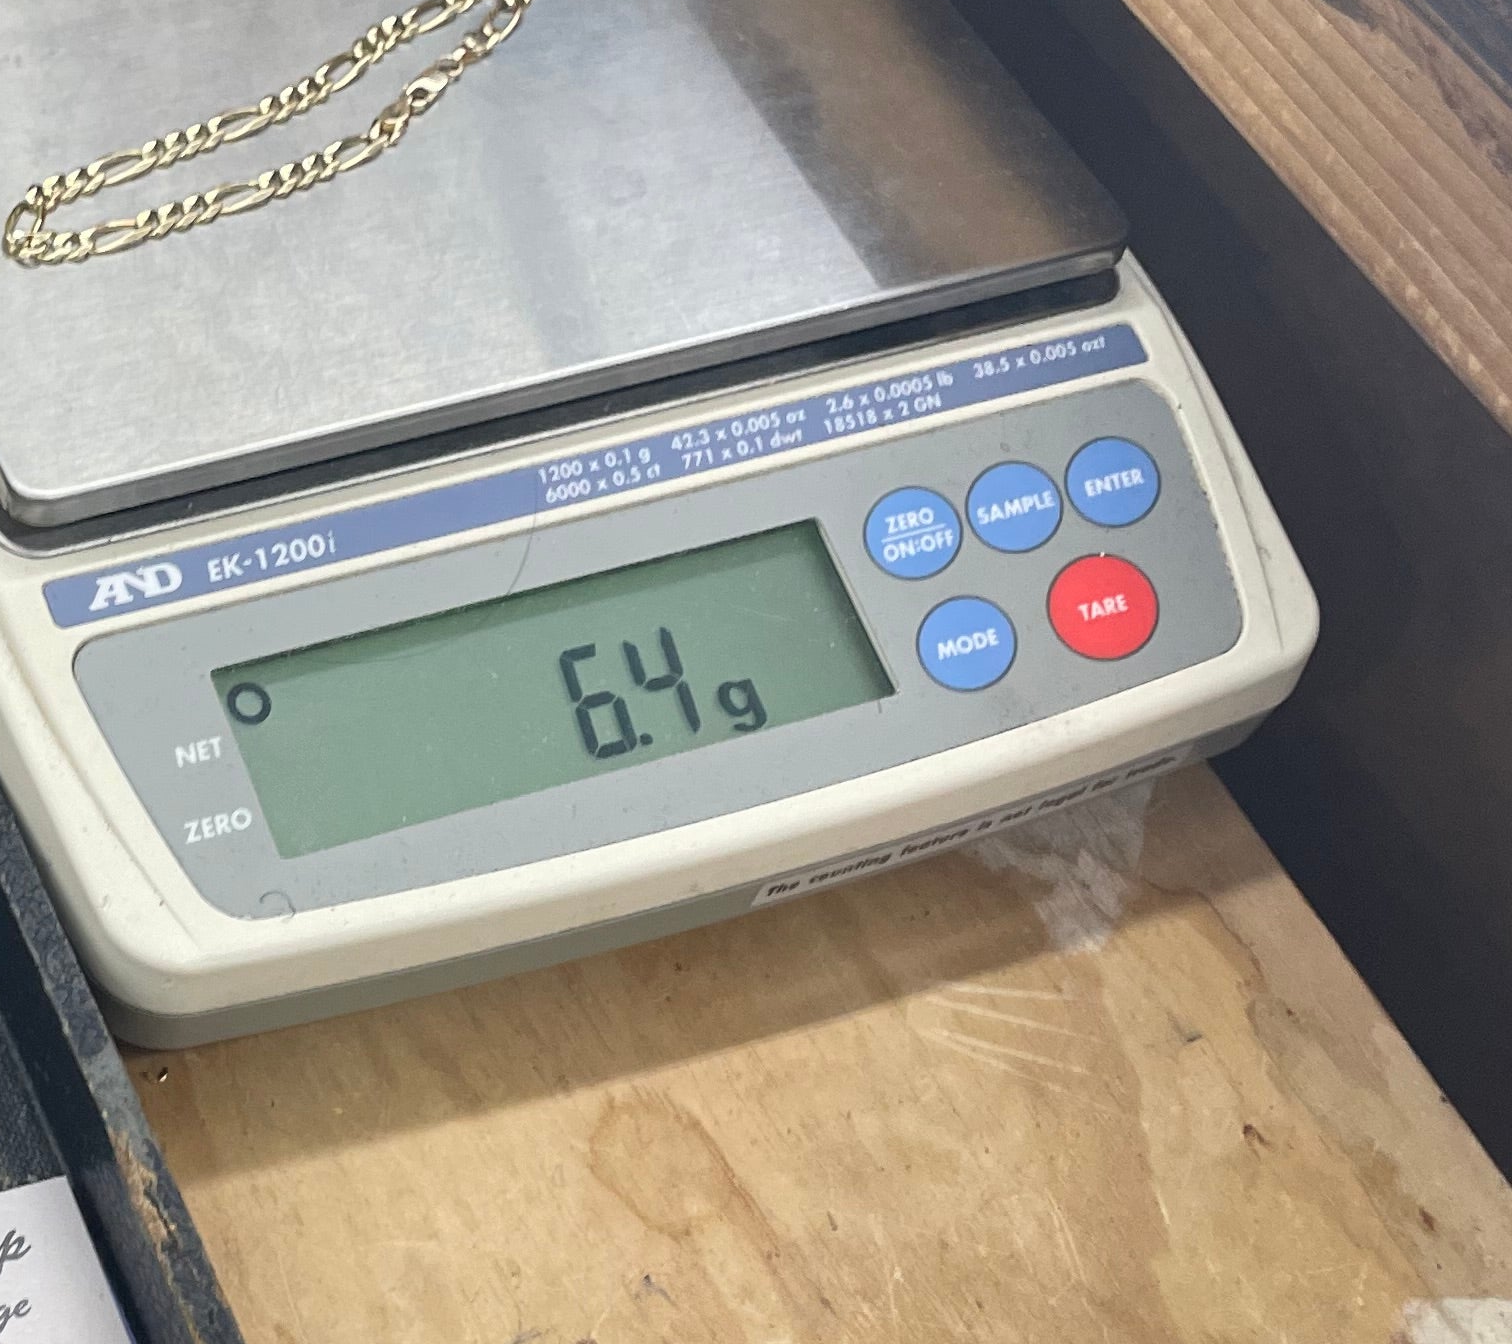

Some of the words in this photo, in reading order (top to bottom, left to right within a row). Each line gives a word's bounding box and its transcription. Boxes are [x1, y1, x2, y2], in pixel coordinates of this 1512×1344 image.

[538, 460, 583, 485] 1200
[590, 460, 600, 473] x
[605, 448, 632, 469] 0.1
[638, 446, 652, 465] g
[671, 428, 711, 452] 42.3
[716, 428, 728, 441] x
[731, 411, 781, 437] 0.005
[785, 408, 807, 425] oz
[826, 393, 854, 415] 2.6
[859, 393, 870, 406] x
[874, 370, 933, 403] 0.0005
[937, 369, 954, 387] lb
[973, 356, 1010, 380] 38.5
[1015, 356, 1027, 368] x
[1030, 341, 1077, 366] 0.005
[545, 478, 591, 505] 6000
[597, 478, 608, 491] x
[612, 465, 641, 488] 0.5
[646, 461, 662, 480] ct
[680, 447, 715, 471] 771
[721, 447, 732, 460] x
[737, 433, 763, 458] 0.1
[769, 428, 804, 450] dwt
[823, 410, 878, 436] 18518
[898, 398, 910, 418] 2
[914, 392, 943, 414] GN
[1084, 467, 1145, 498] ENTER
[885, 507, 934, 534] ZERO
[976, 490, 1056, 525] SAMPLE
[88, 561, 184, 612] AND
[206, 529, 338, 584] EK-1200i
[1077, 593, 1129, 622] TARE
[937, 628, 1000, 660] MODE
[559, 626, 701, 760] 6.4
[717, 677, 768, 733] g
[174, 736, 222, 768] NET
[184, 807, 253, 845] ZERO
[767, 880, 801, 897] The
[809, 853, 892, 885] counting
[899, 828, 969, 858] feature
